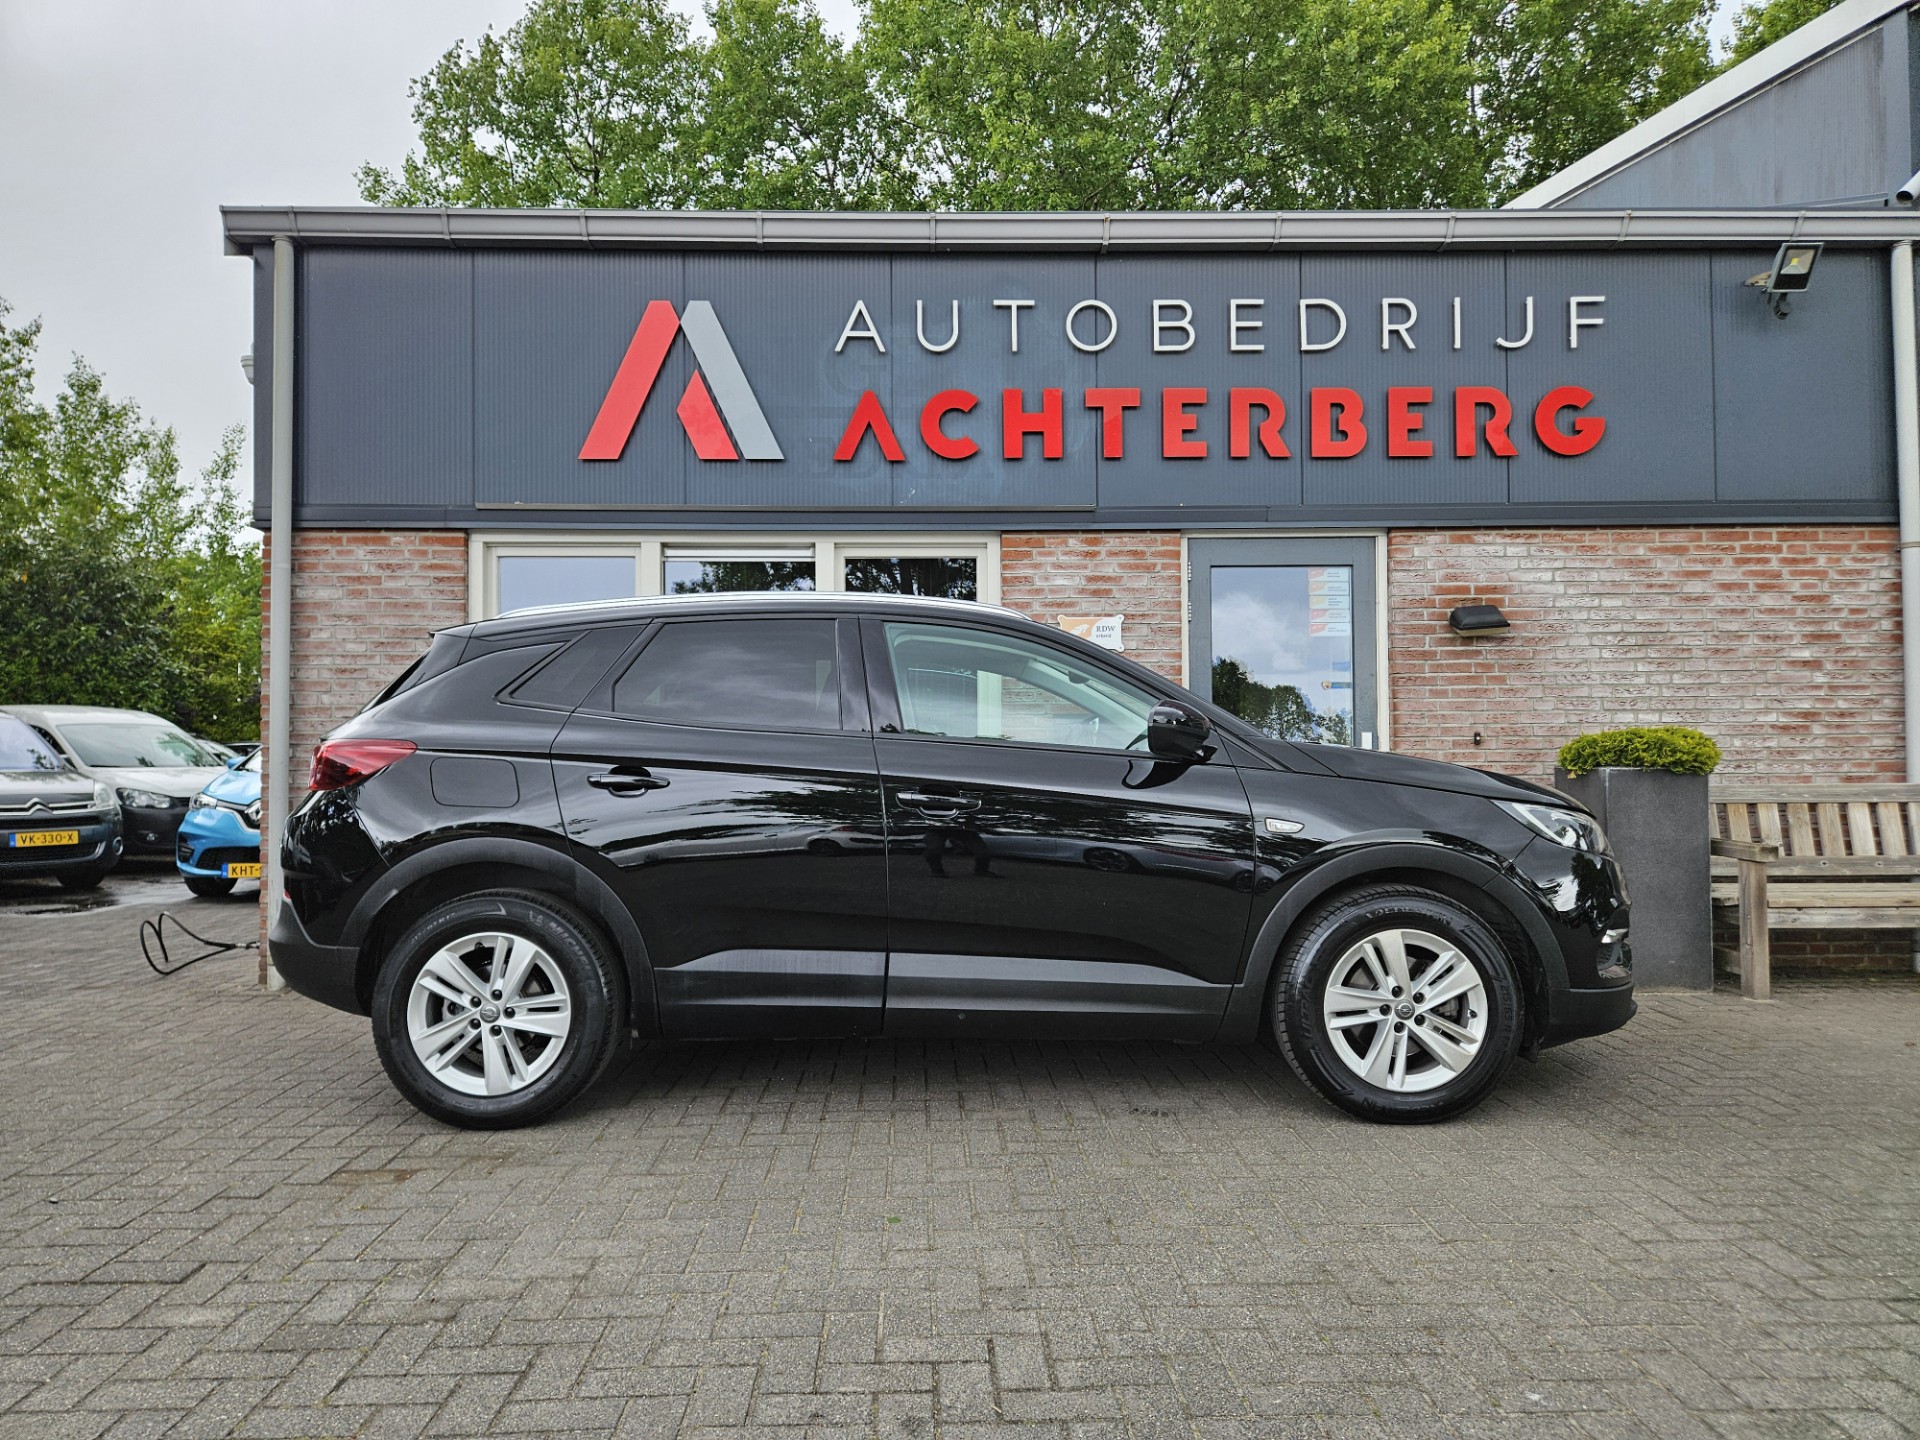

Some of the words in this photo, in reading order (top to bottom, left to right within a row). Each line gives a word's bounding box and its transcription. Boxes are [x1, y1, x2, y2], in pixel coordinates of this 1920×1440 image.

[835, 296, 1606, 353] AUTOBEDRIJF
[833, 386, 1606, 461] ACHTERBERG
[1096, 625, 1116, 633] RDW
[20, 832, 74, 845] VK-330-X
